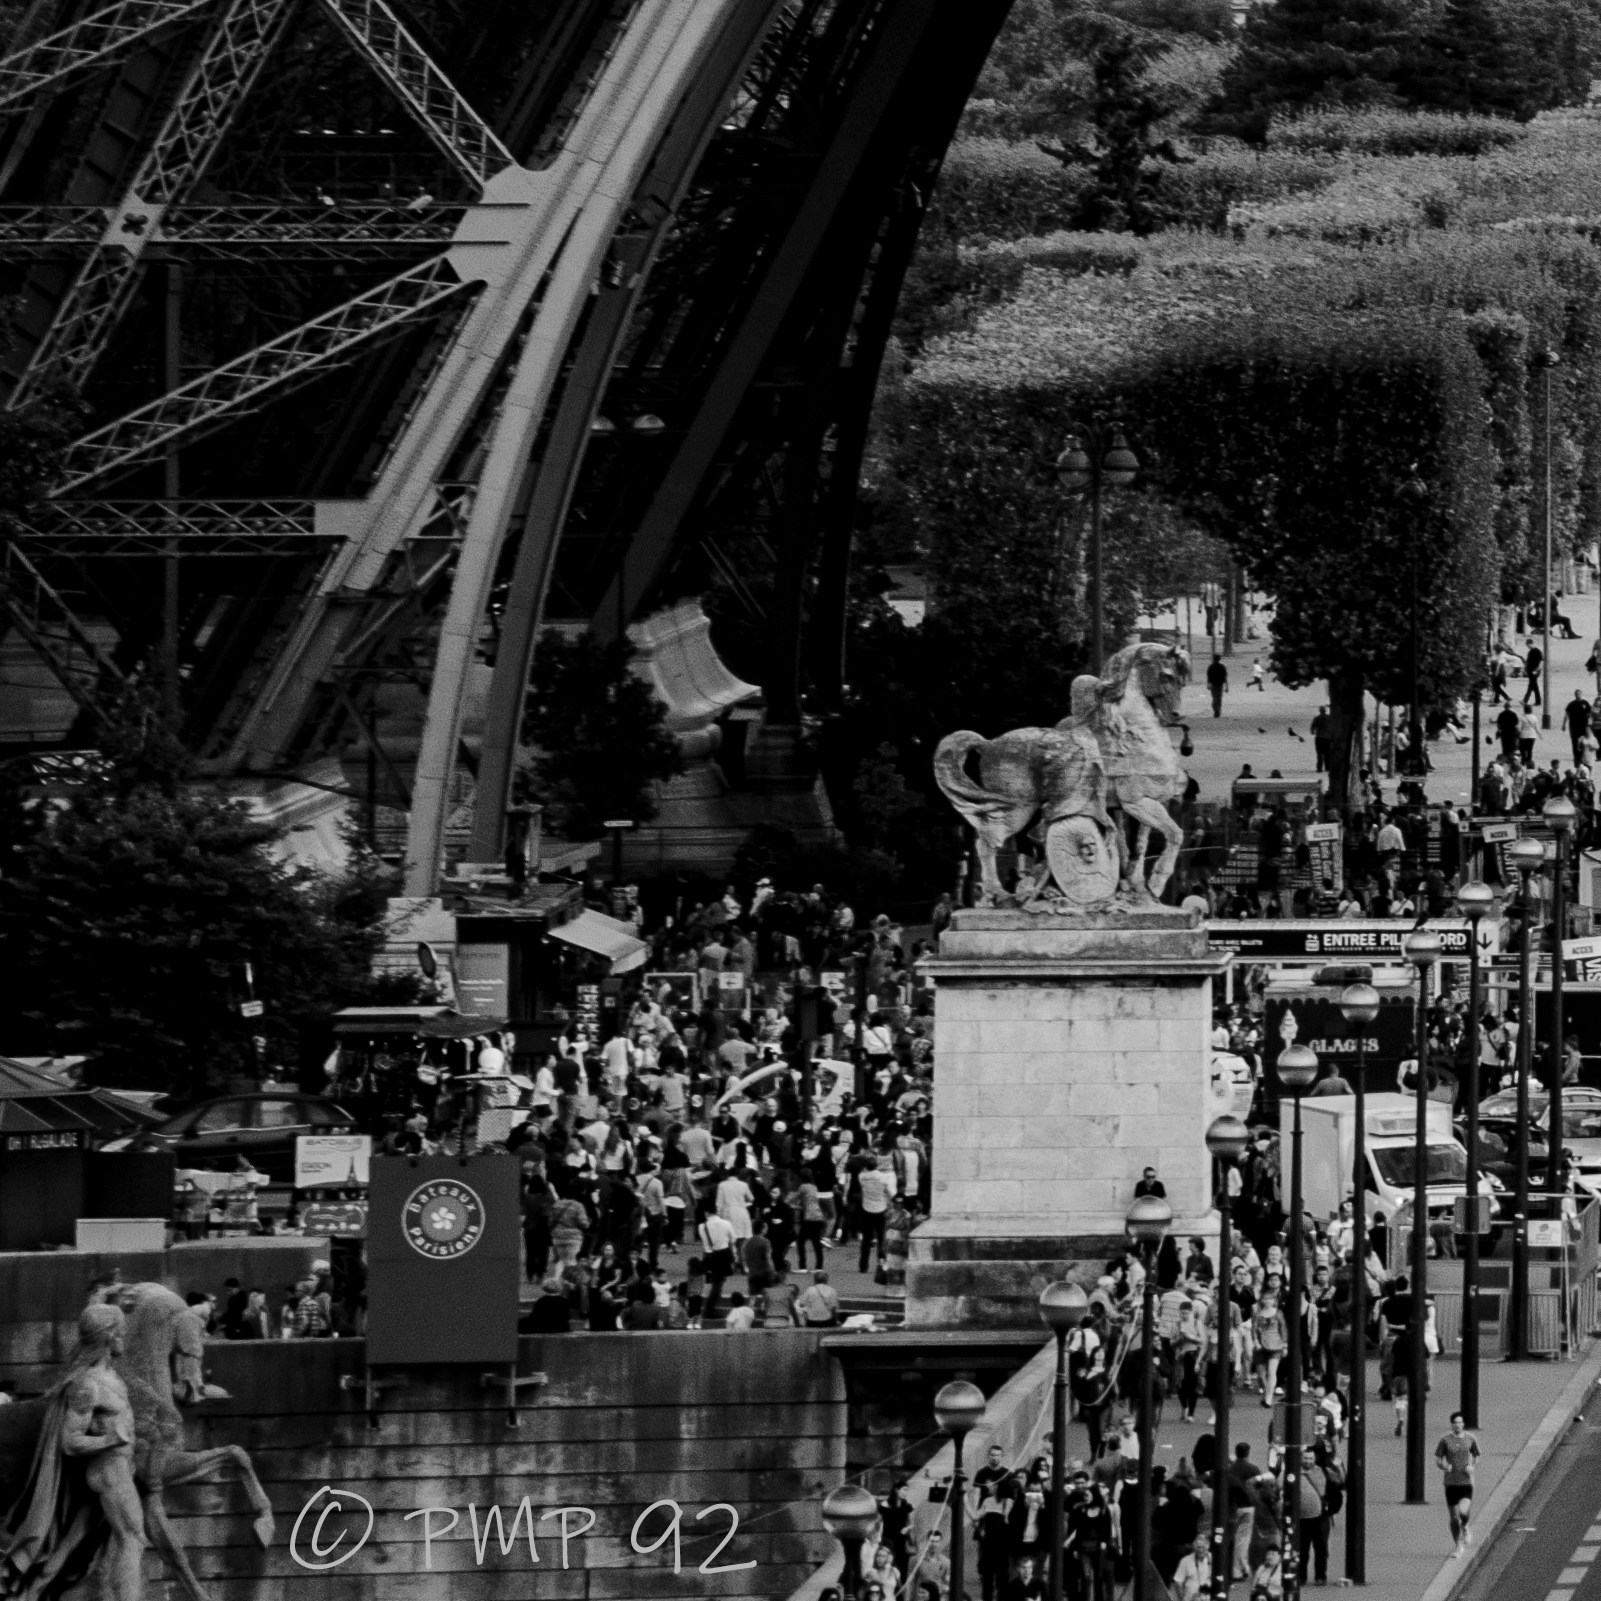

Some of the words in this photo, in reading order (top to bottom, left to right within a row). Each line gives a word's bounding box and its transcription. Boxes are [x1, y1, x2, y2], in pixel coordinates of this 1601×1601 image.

[1323, 932, 1377, 947] ENTREE
[1438, 932, 1467, 947] ORD
[408, 1185, 478, 1213] Bateaux
[409, 1226, 480, 1256] Parisiens
